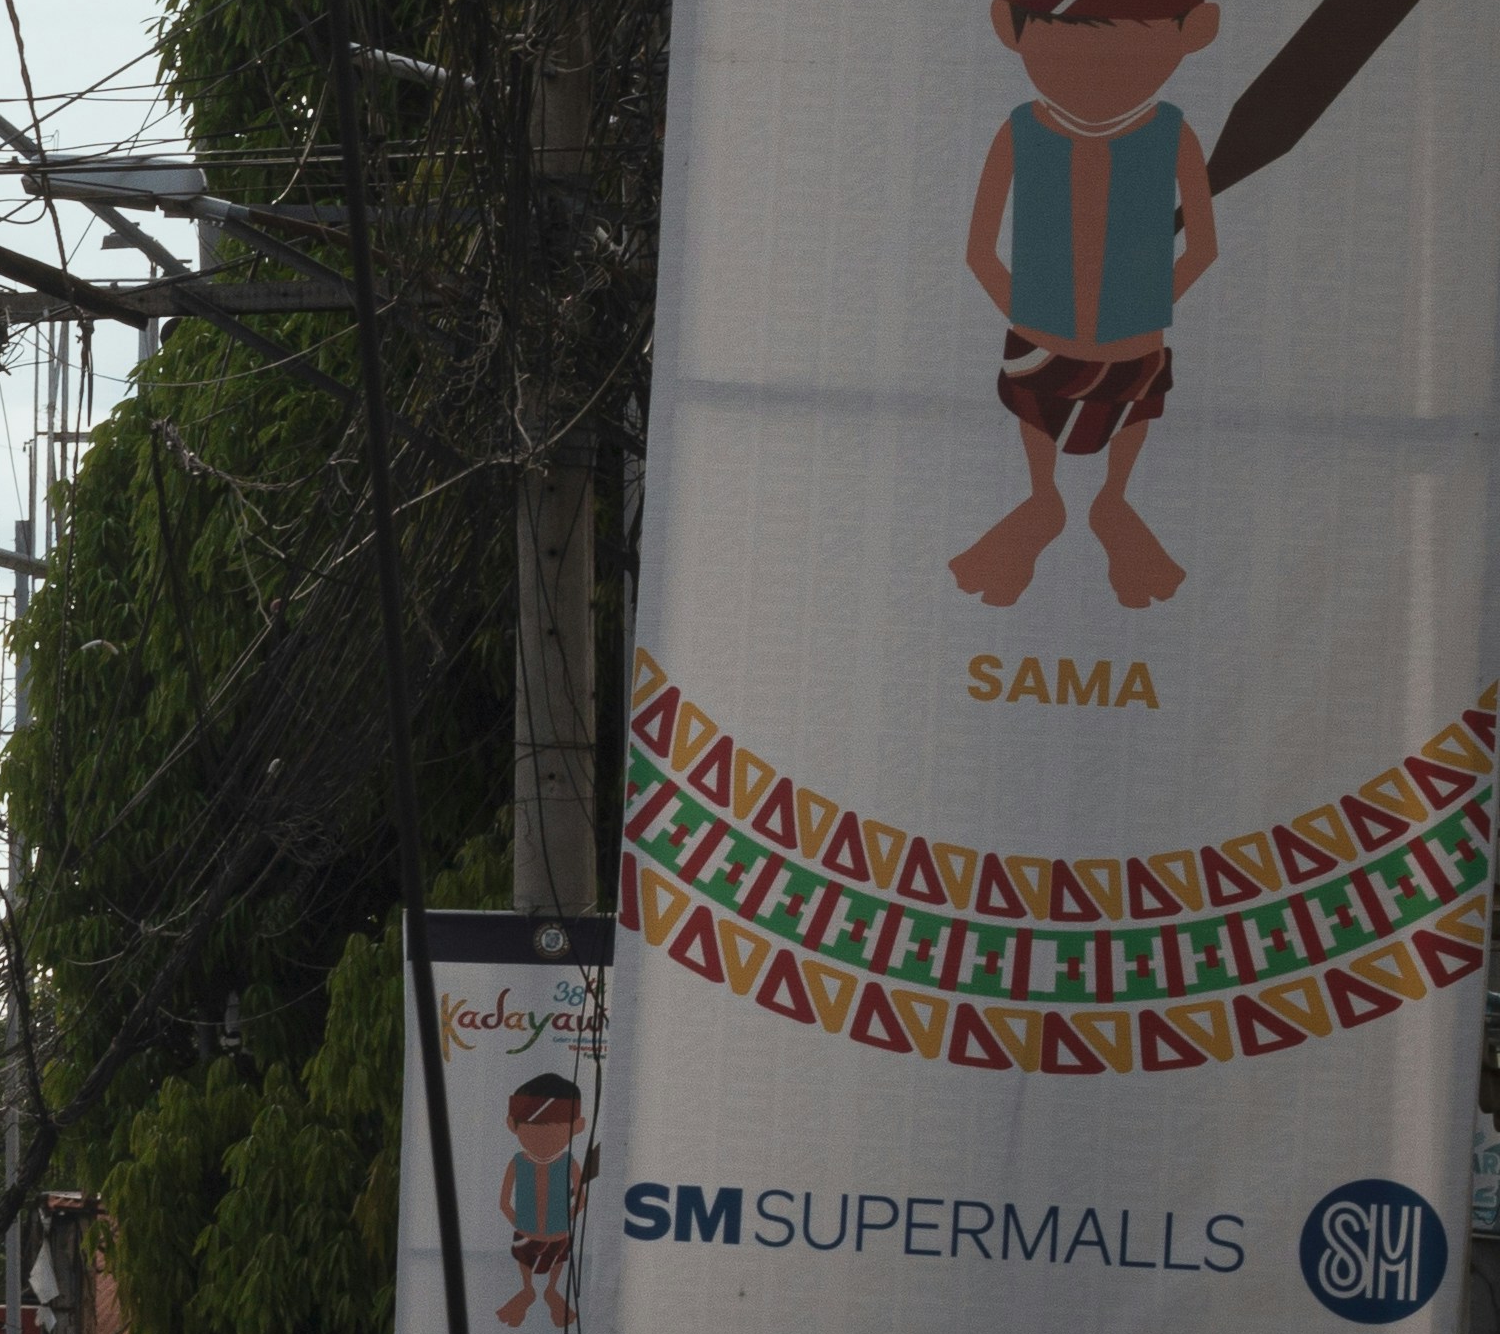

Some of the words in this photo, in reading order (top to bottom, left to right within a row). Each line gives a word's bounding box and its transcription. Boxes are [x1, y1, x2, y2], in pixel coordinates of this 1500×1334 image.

[966, 653, 1161, 710] SAMA
[624, 1183, 742, 1245] SM
[755, 1189, 1246, 1273] SUPERMALLS
[1319, 1200, 1420, 1302] SM
